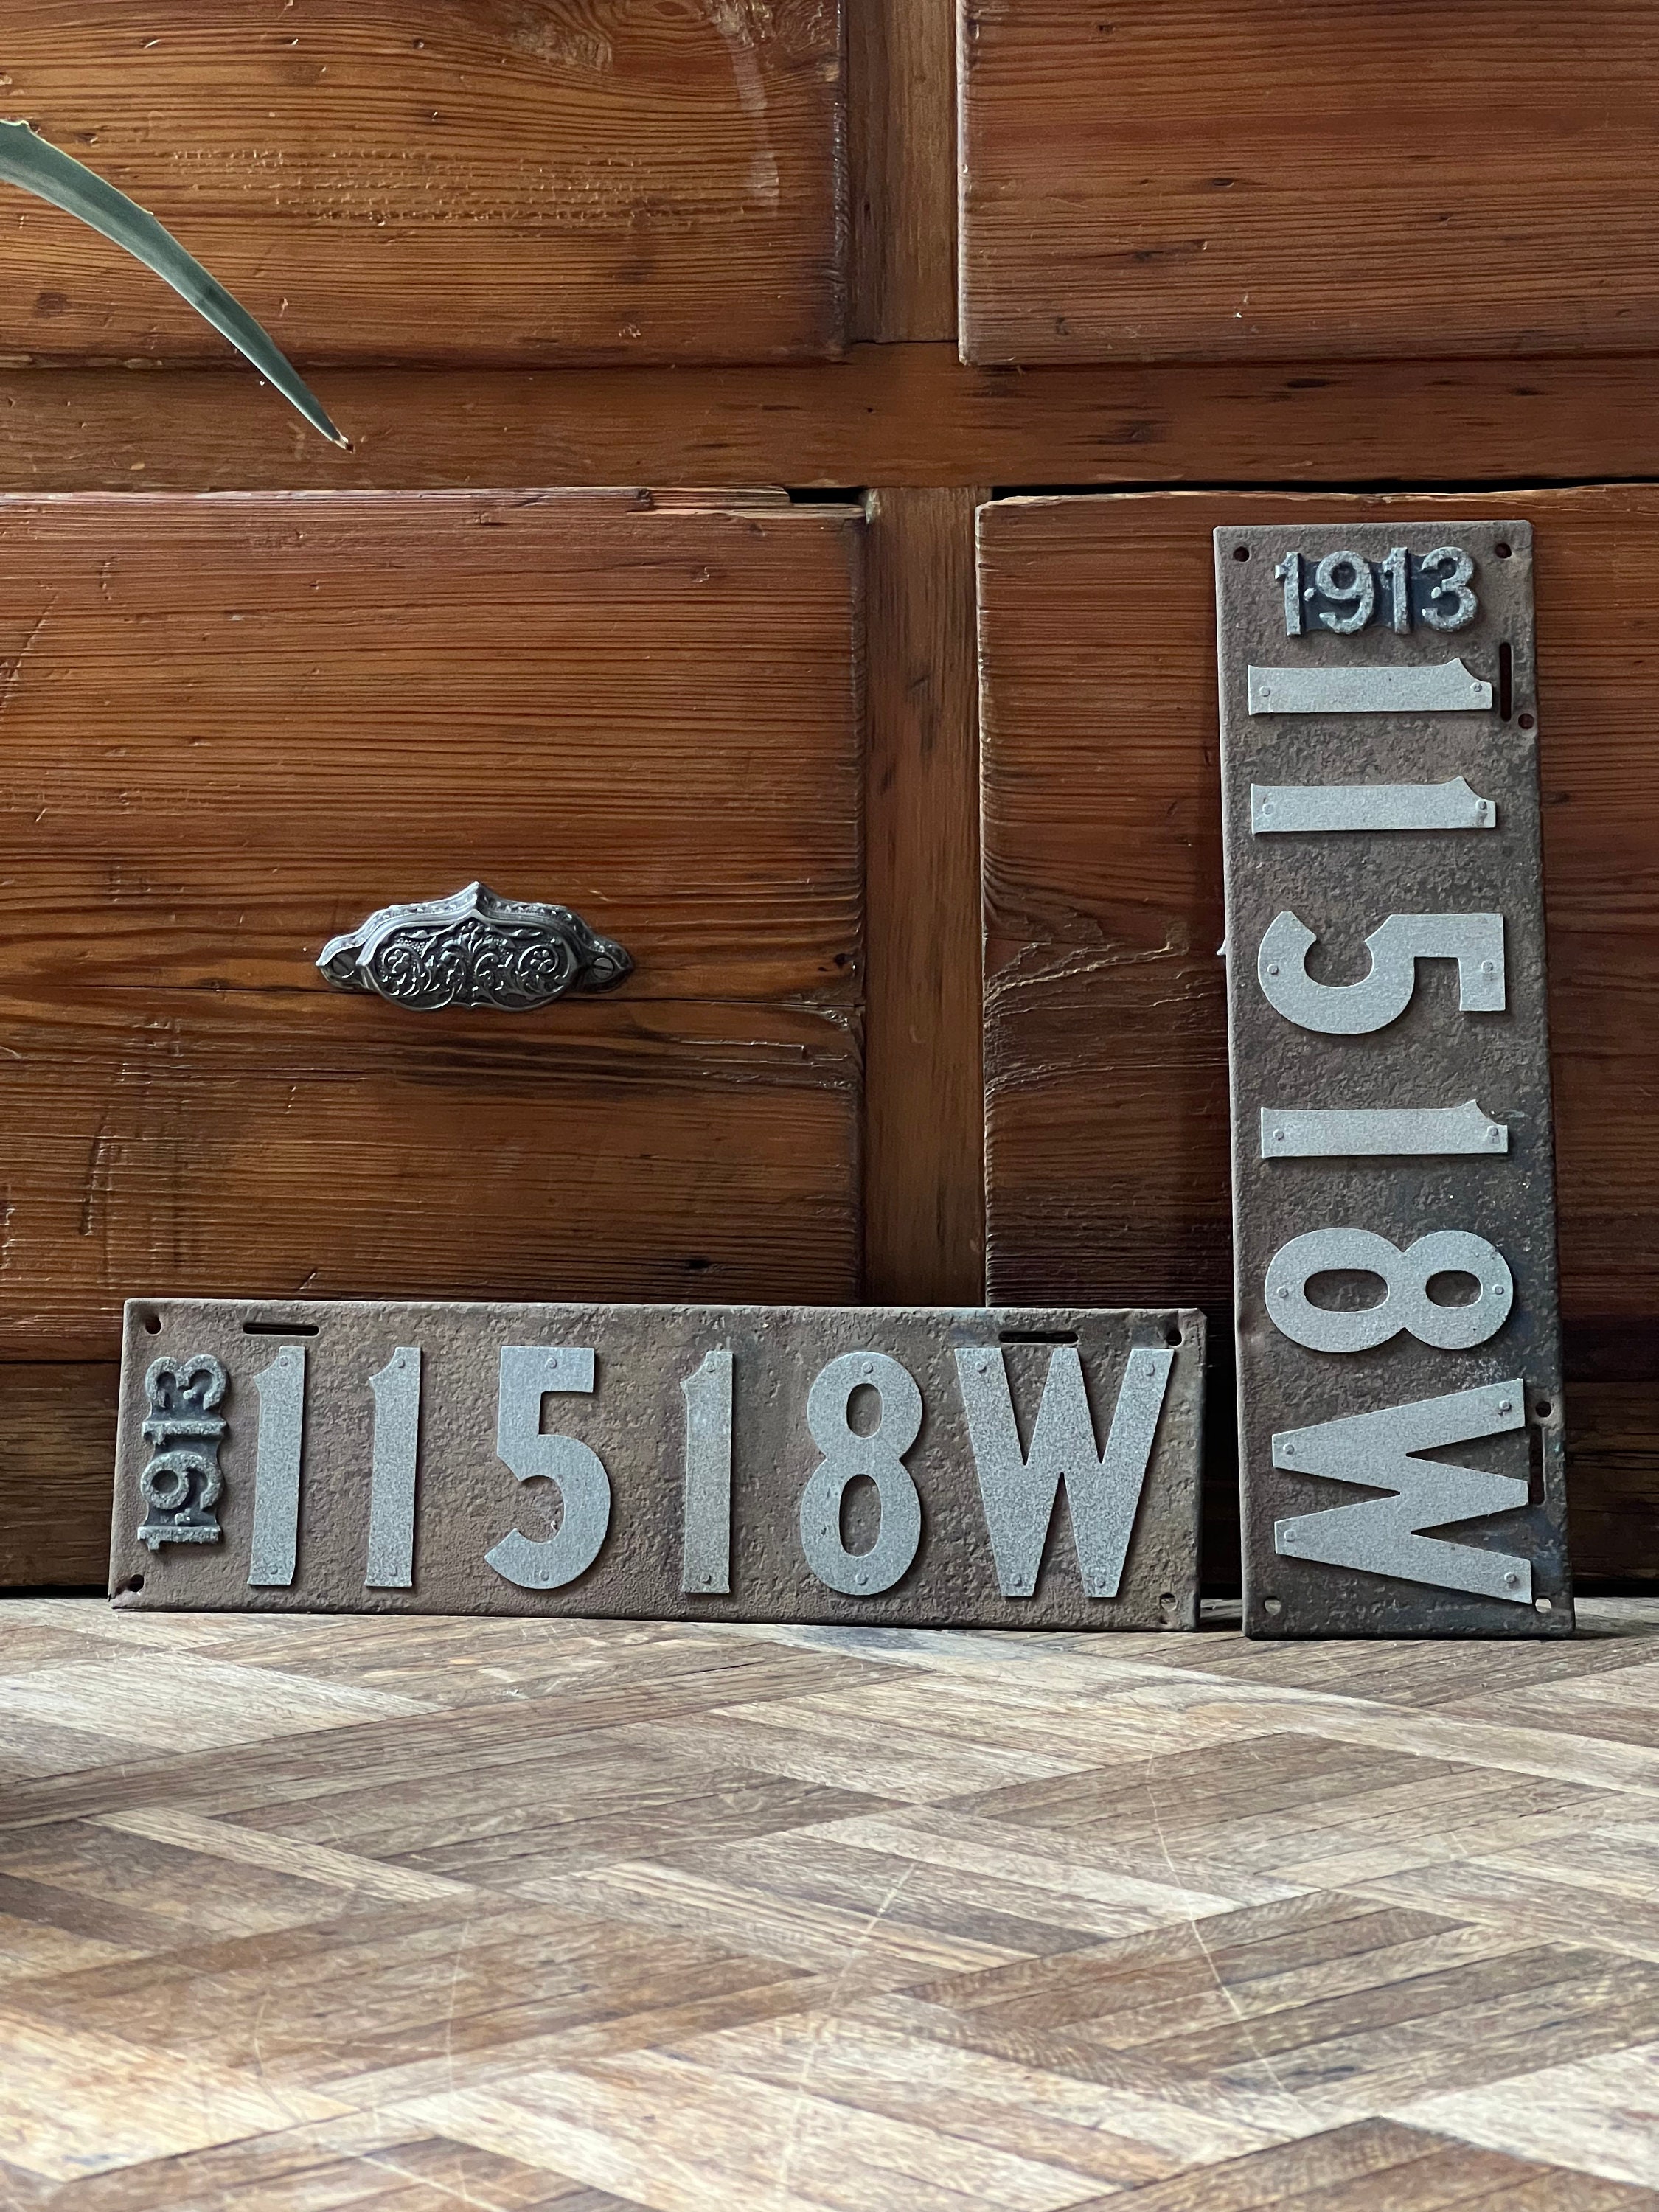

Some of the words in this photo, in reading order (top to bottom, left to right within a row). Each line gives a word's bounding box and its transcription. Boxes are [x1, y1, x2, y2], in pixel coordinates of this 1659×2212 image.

[1275, 546, 1480, 637] 1913
[1248, 657, 1533, 1604] 11518W
[137, 1354, 227, 1553] 1913
[247, 1345, 1174, 1600] 11518W
